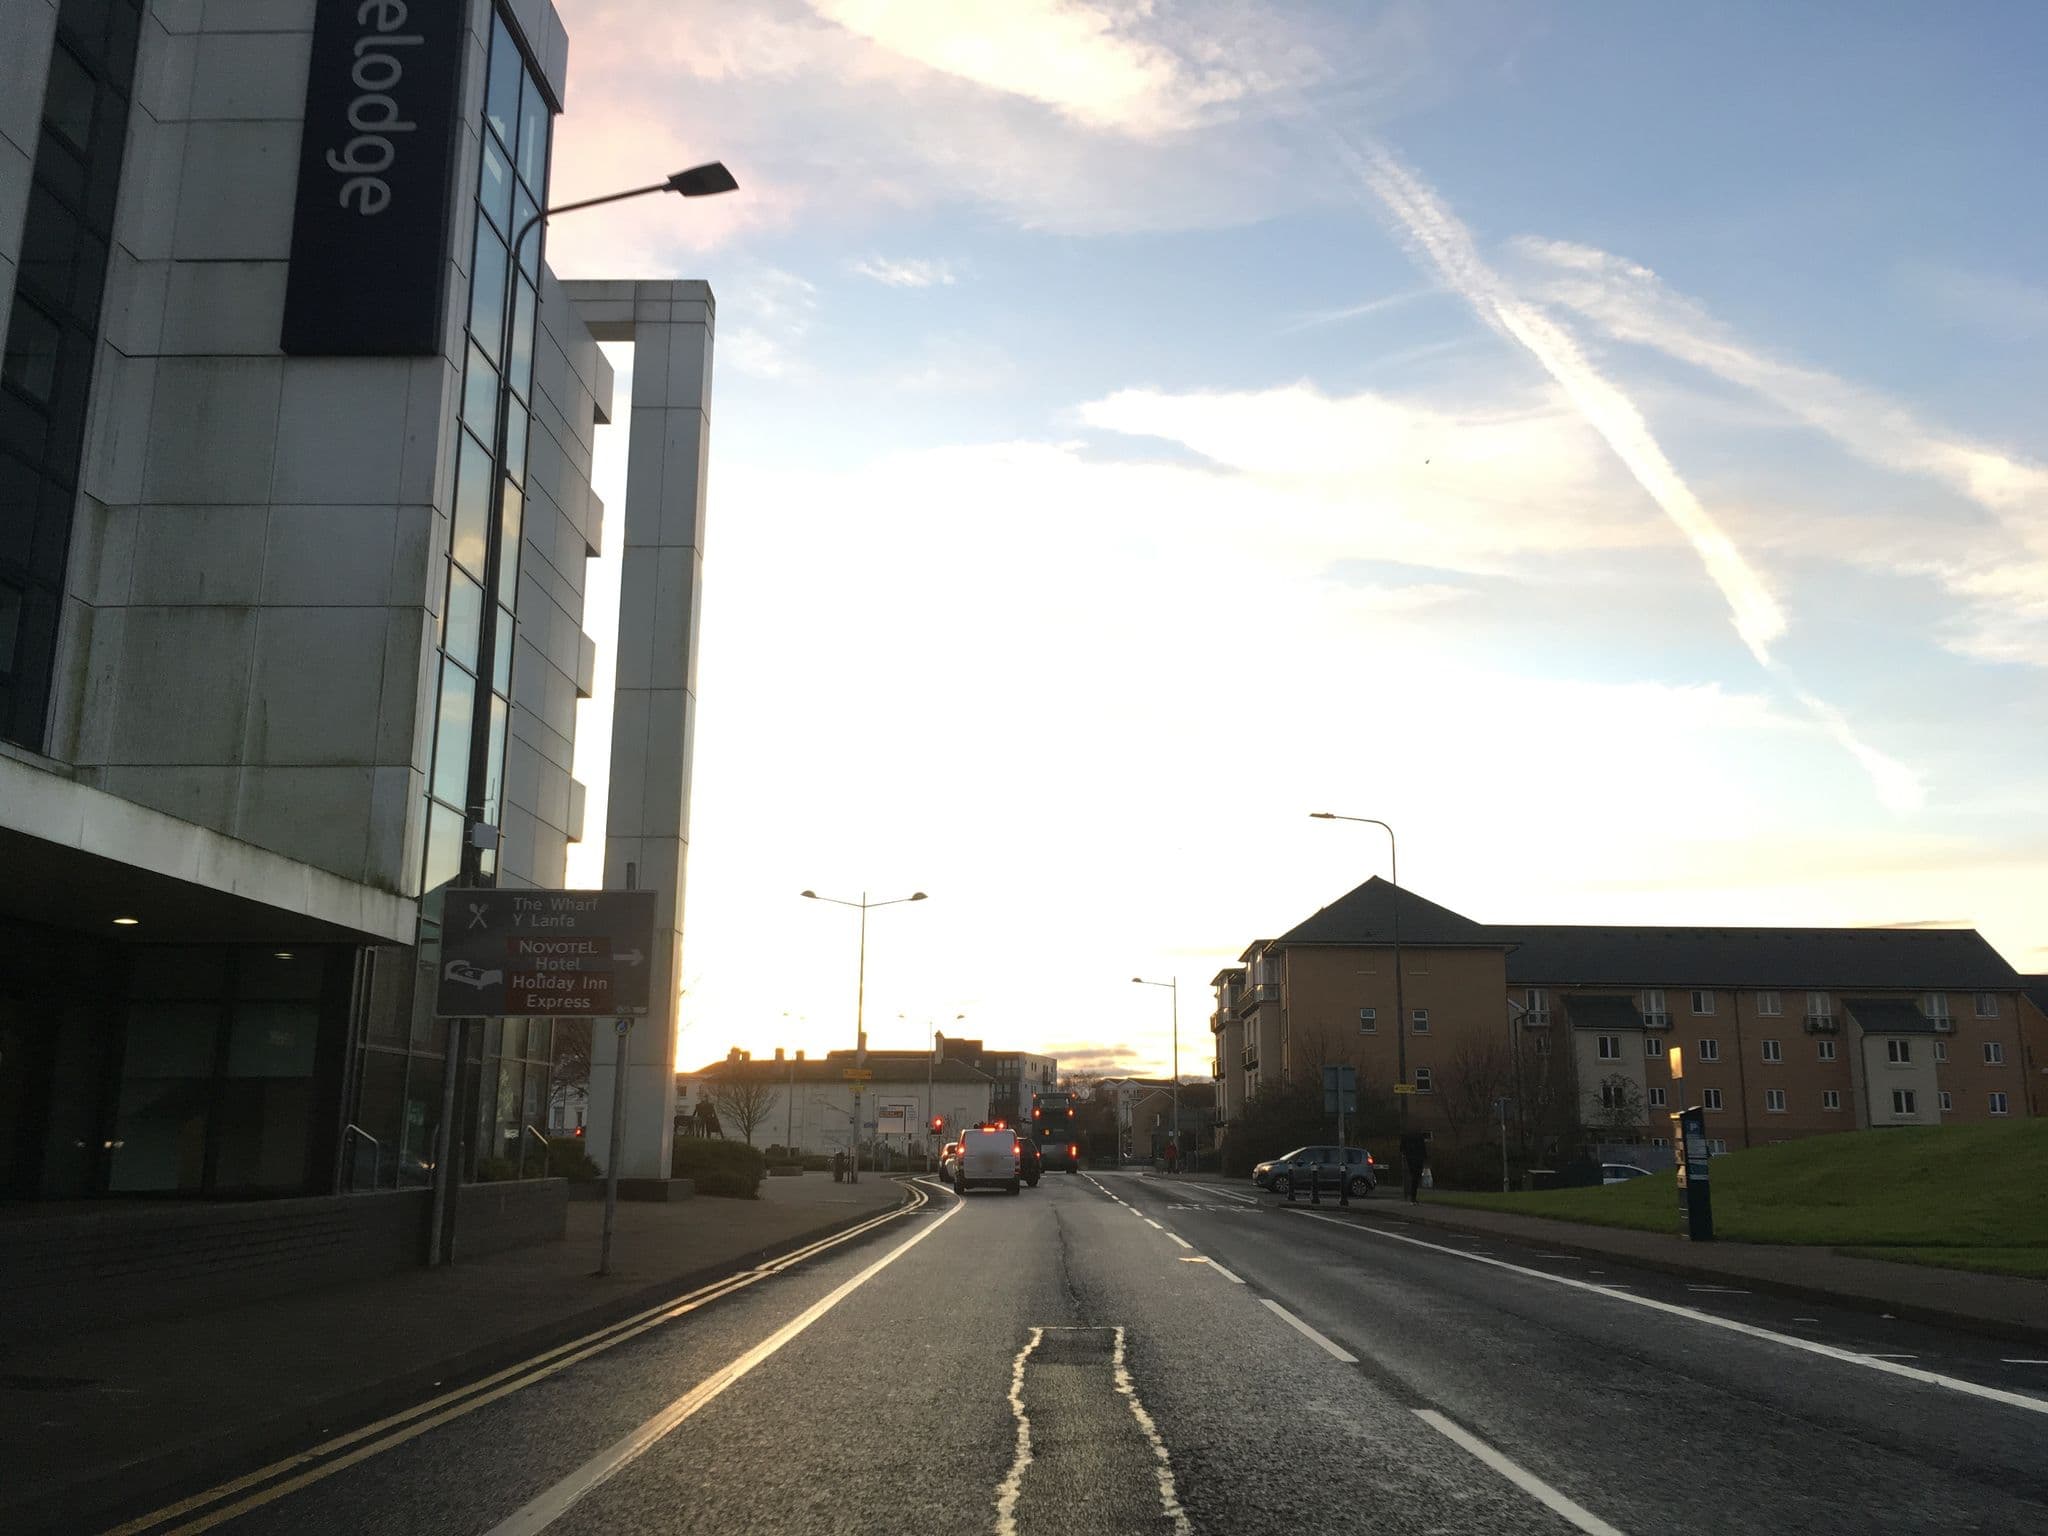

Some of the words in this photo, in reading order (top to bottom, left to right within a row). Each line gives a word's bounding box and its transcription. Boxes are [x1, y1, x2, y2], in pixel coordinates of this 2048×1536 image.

[326, 0, 425, 215] elodge
[514, 897, 542, 911] The
[551, 897, 599, 911] Wharf
[513, 914, 522, 927] Y
[531, 914, 576, 927] Lanfa
[519, 940, 599, 954] NOVOTEL
[536, 957, 581, 970] Hotel
[513, 975, 575, 991] Holiday
[583, 977, 608, 990] Inn
[527, 994, 591, 1009] Express
